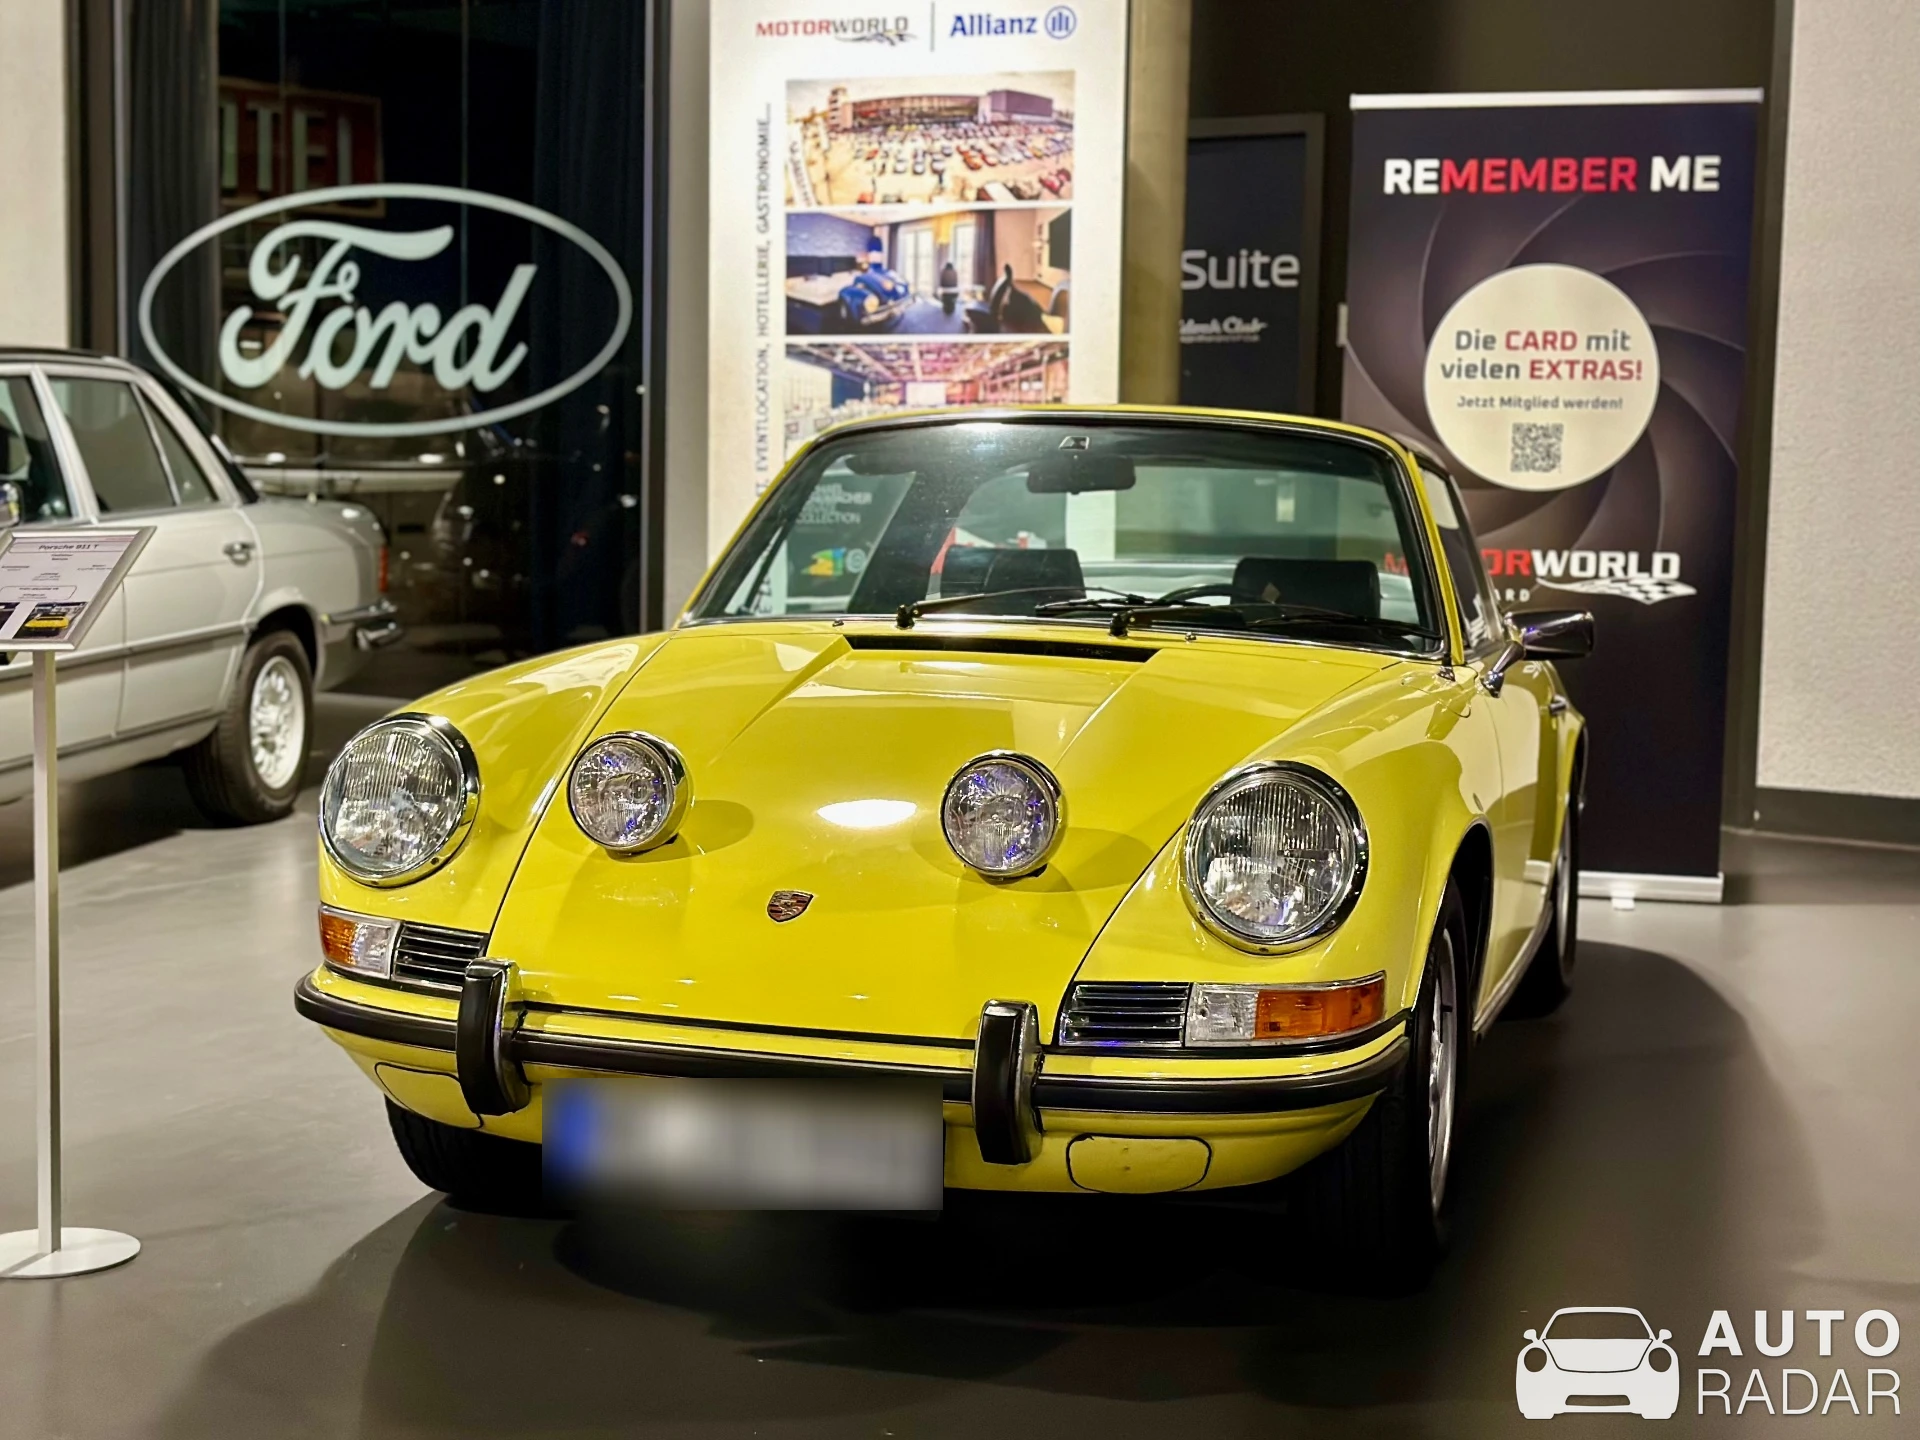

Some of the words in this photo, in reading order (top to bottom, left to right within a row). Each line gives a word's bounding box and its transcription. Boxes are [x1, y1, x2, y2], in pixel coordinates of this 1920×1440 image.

[756, 15, 909, 37] MOTORWORLD
[951, 13, 1037, 37] Allianz
[1383, 157, 1637, 195] REMEMBER
[1650, 155, 1721, 192] ME
[1180, 248, 1300, 290] Suite
[756, 240, 771, 337] HOTELLERIE,
[219, 219, 538, 393] Ford
[1455, 329, 1497, 351] Die
[1505, 330, 1578, 351] CARD
[1586, 329, 1631, 351] mit
[1441, 358, 1520, 380] vielen
[1529, 359, 1643, 381] EXTRAS!
[1457, 396, 1495, 408] Jetzt
[1500, 396, 1559, 411] Mitglied
[1563, 397, 1623, 409] werden!
